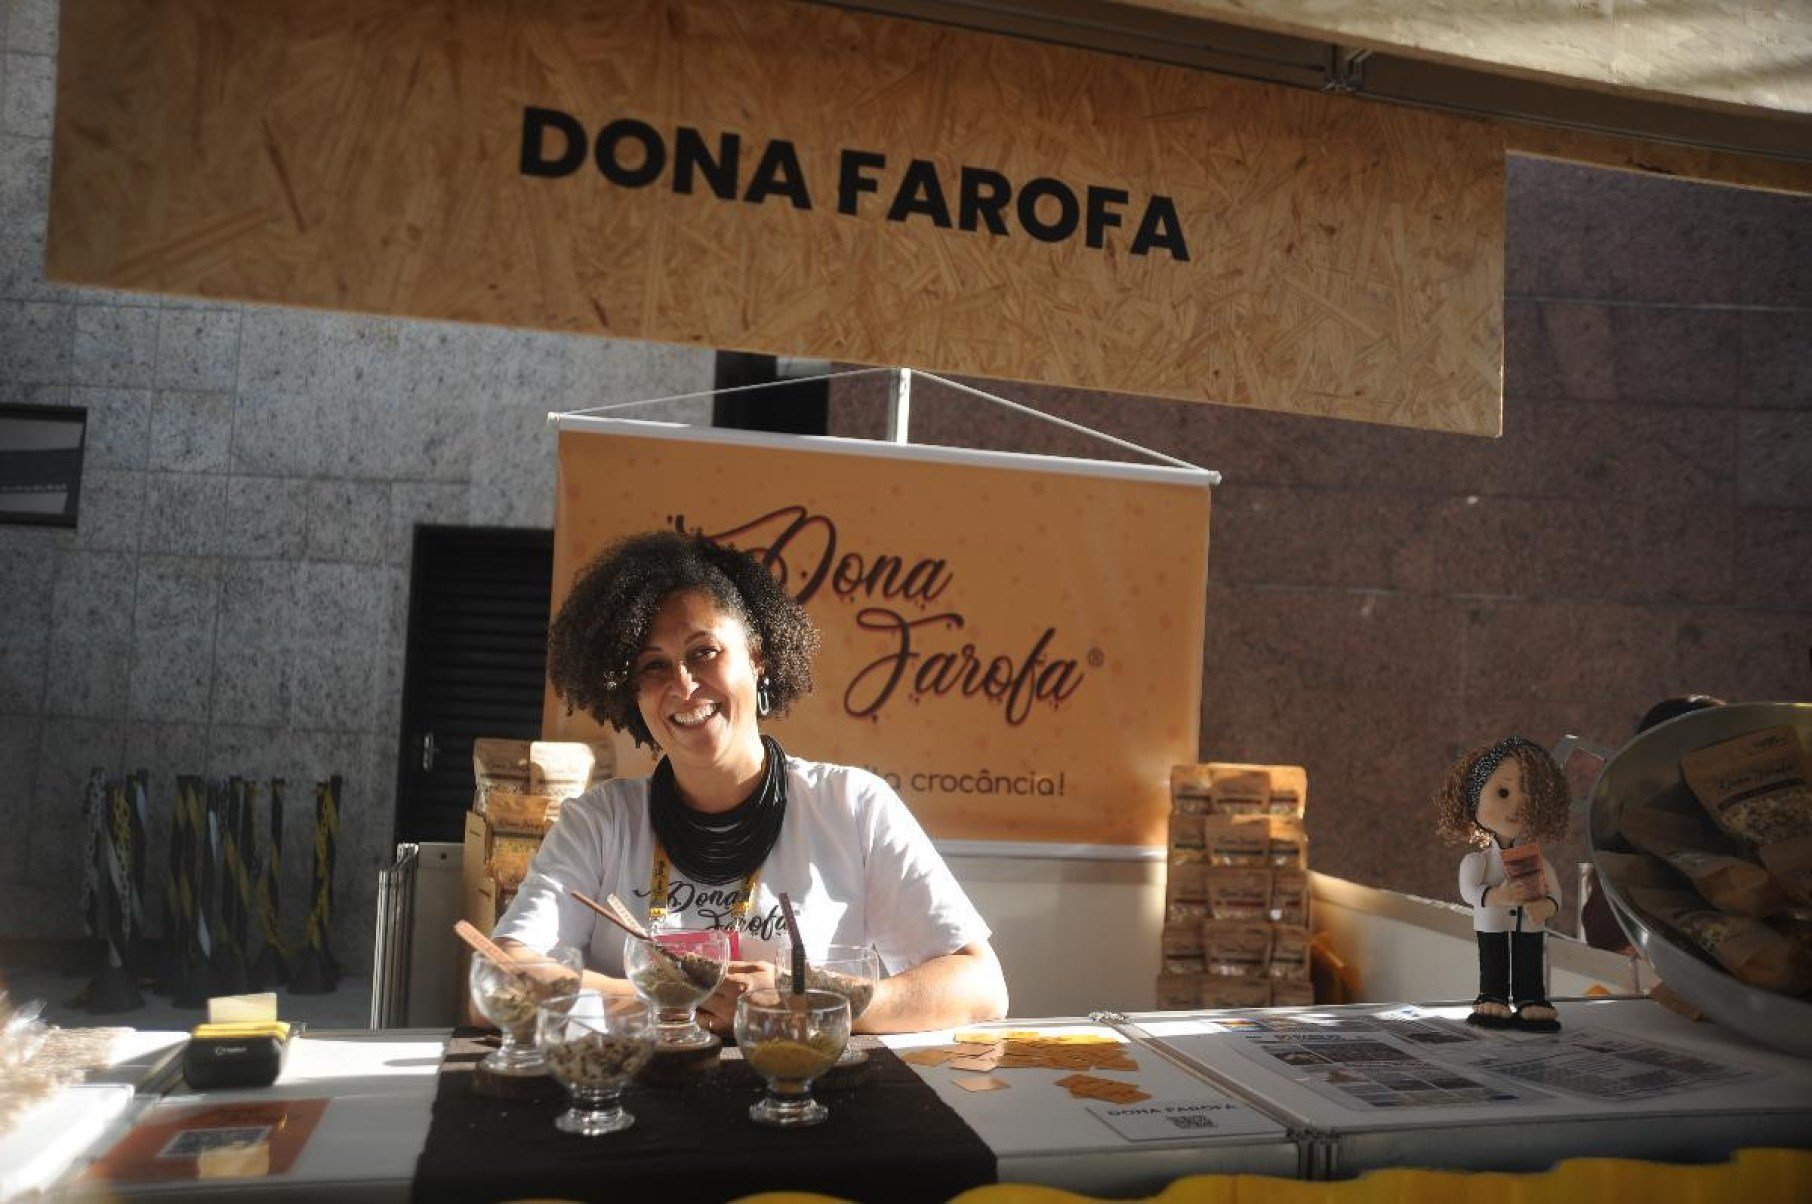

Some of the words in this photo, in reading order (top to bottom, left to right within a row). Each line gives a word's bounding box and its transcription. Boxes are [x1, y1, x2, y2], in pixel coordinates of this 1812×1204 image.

[519, 106, 812, 211] DONA
[836, 147, 1191, 262] FAROFA
[700, 505, 953, 604] Dona
[911, 768, 1064, 797] crocância!
